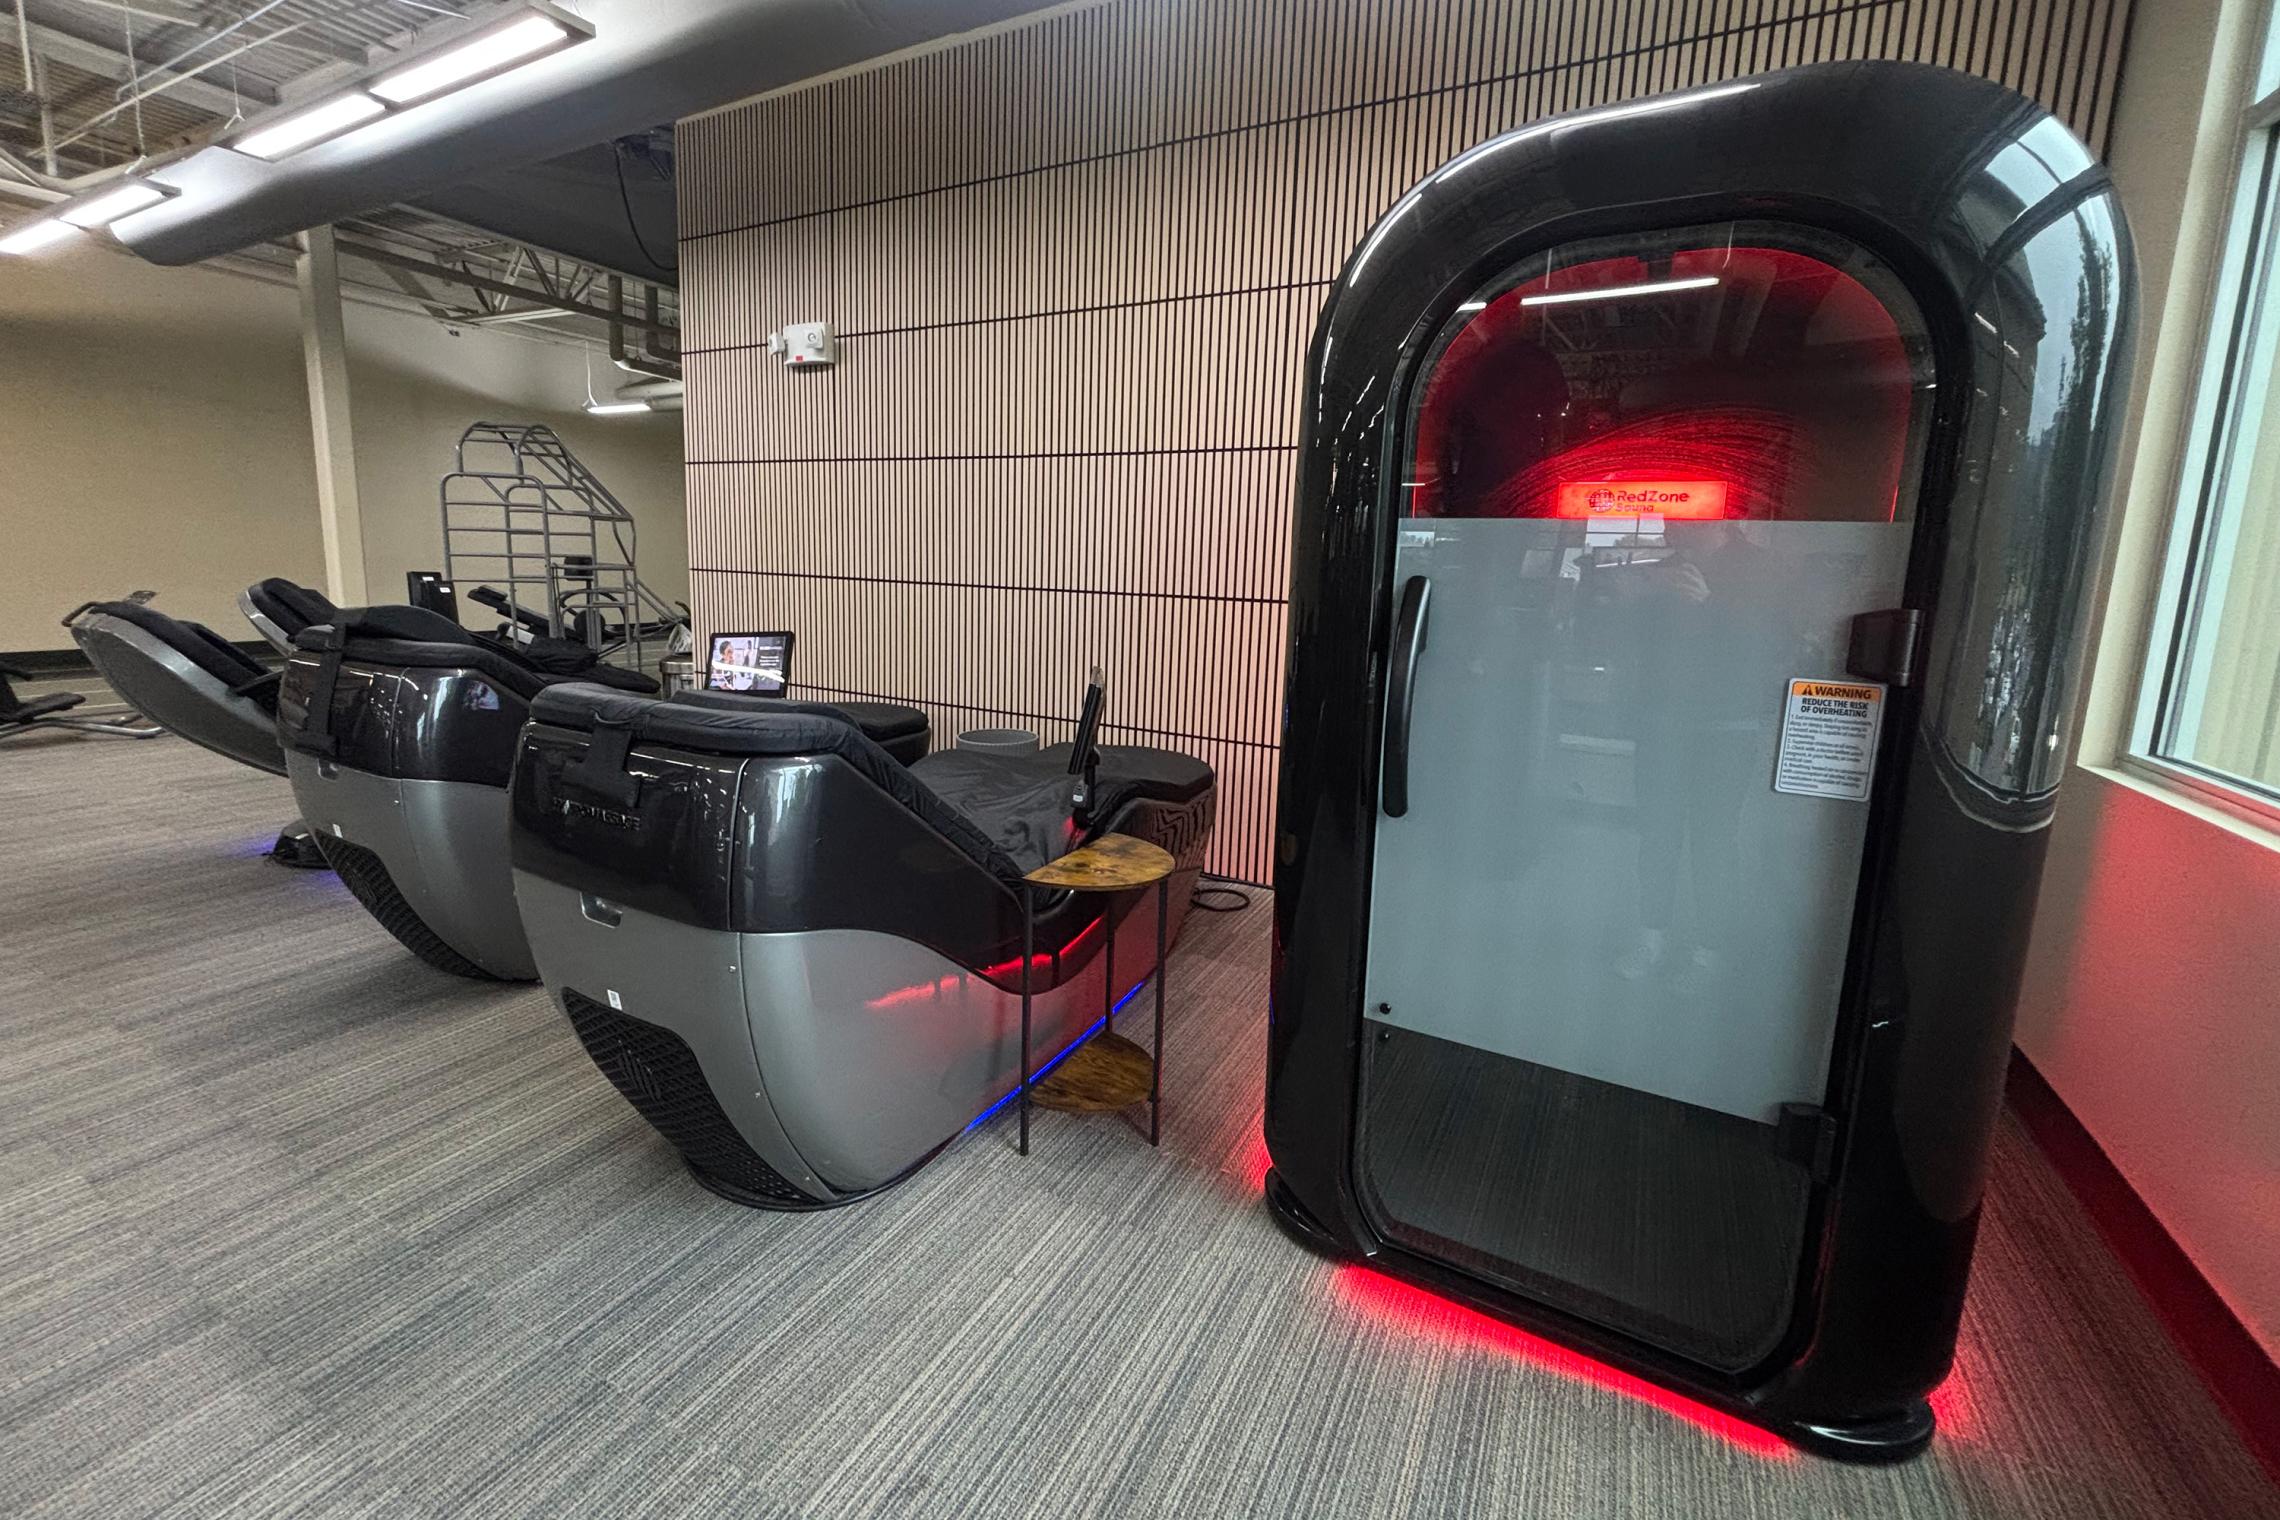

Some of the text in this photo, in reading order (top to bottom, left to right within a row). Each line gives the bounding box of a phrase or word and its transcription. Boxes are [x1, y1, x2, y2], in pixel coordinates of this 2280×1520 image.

[1617, 490, 1690, 502] RedZone
[1616, 503, 1654, 512] Sauna
[1815, 686, 1872, 699] WARNING
[1802, 698, 1869, 710] REDUCE THE RISK
[1812, 707, 1868, 718] OVERHEATING
